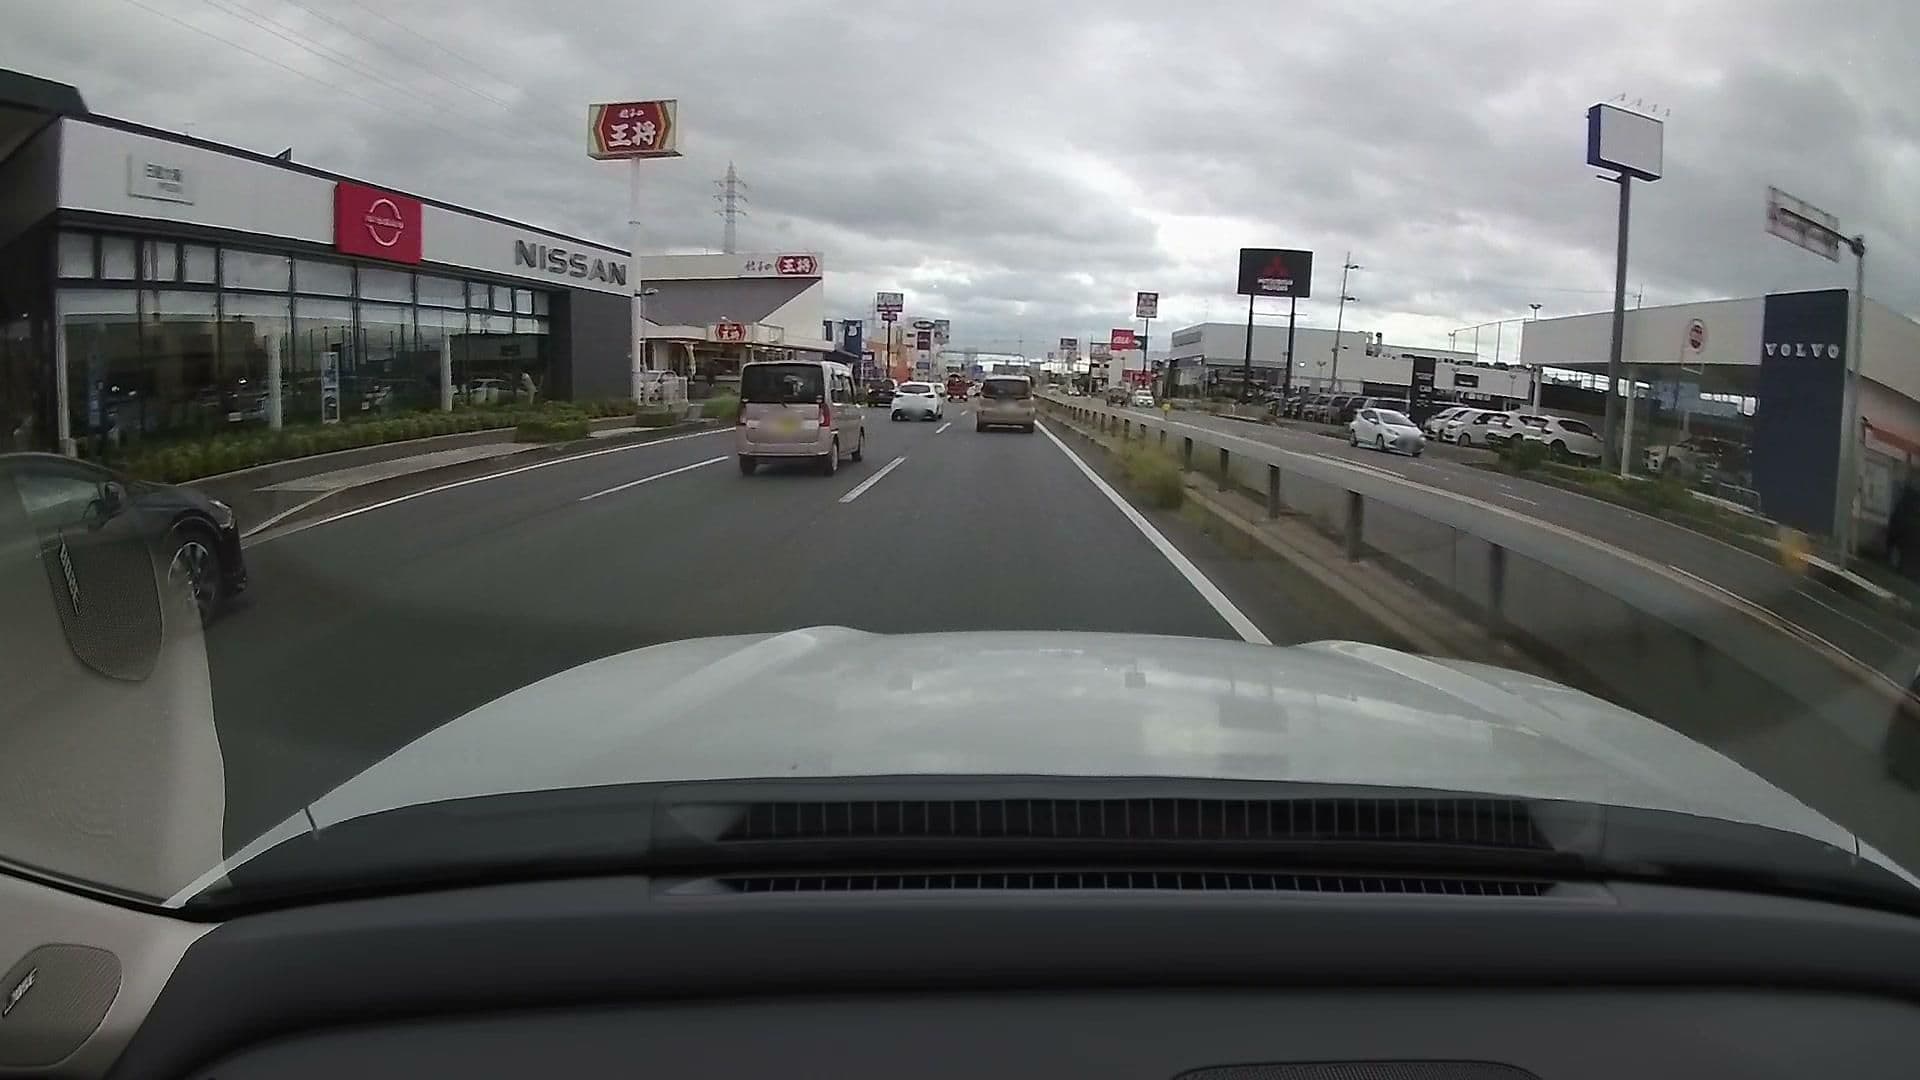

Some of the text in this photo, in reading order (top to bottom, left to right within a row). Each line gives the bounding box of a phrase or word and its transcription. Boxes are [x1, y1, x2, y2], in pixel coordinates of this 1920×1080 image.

[608, 121, 657, 147] 王将
[515, 239, 627, 286] NISSAN
[781, 258, 811, 273] 王将
[1764, 342, 1840, 359] VOLVO
